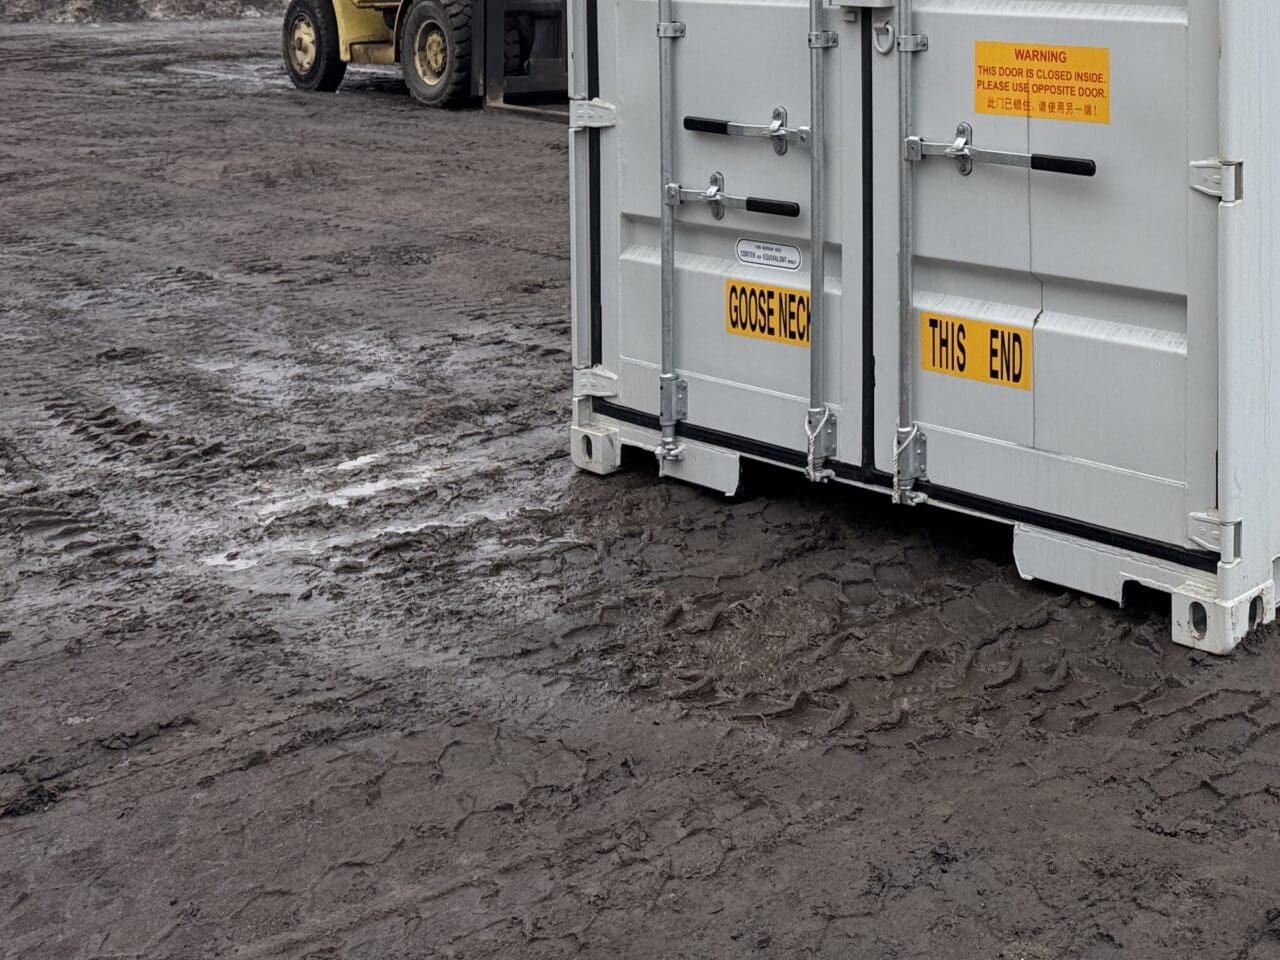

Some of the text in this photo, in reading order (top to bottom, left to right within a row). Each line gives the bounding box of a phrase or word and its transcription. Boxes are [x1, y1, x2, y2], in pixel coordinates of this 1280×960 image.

[1014, 48, 1067, 64] WARNING
[978, 65, 997, 77] THIS
[998, 67, 1023, 78] DOOR
[1025, 68, 1034, 79] IS
[1036, 69, 1072, 81] CLOSED
[977, 79, 1010, 91] PLEASE
[1012, 82, 1030, 93] USE
[1032, 83, 1076, 97] OPPOSITE
[729, 285, 775, 336] GOOSE
[928, 318, 1023, 383] THIS END
